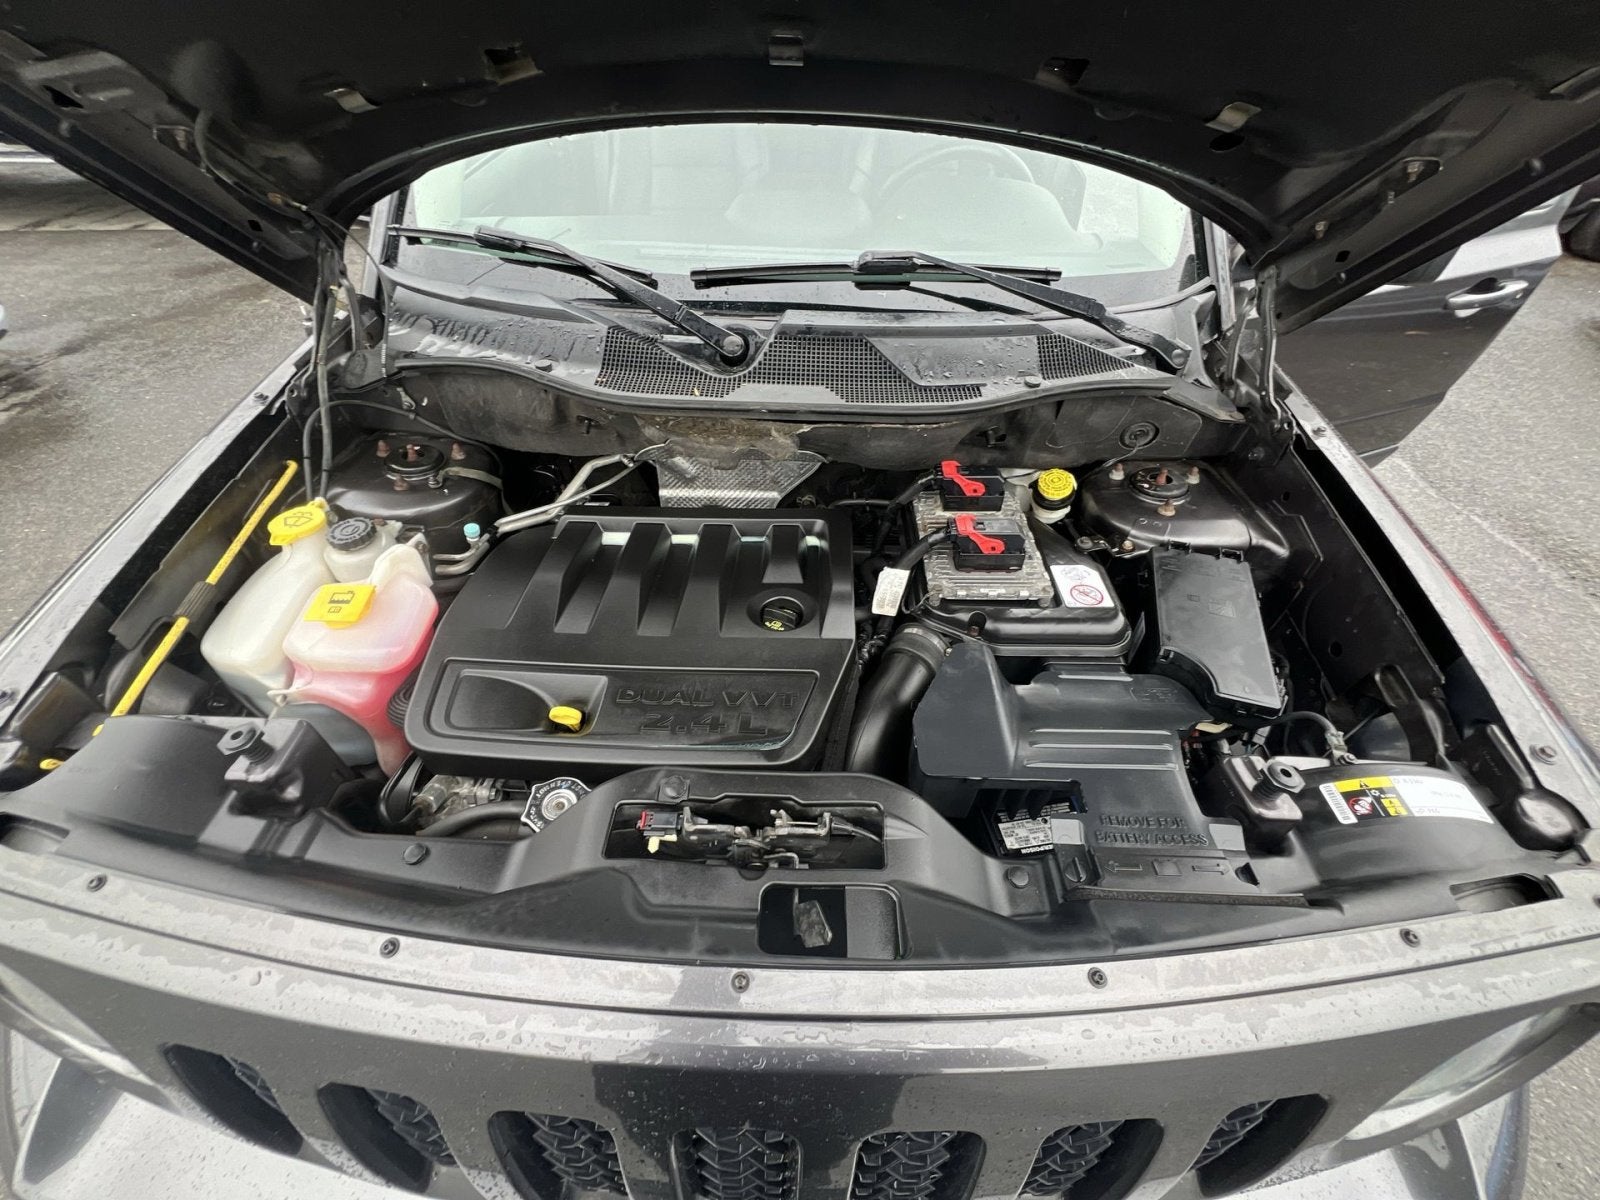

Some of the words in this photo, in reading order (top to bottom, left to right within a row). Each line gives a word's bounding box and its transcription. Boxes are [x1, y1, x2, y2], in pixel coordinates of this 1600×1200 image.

[616, 688, 714, 707] DUAL
[722, 691, 797, 708] VVT
[1100, 815, 1156, 829] REMOVE
[1157, 817, 1187, 829] FOR
[1095, 830, 1150, 844] BATTERY
[1155, 833, 1208, 846] ACCESS
